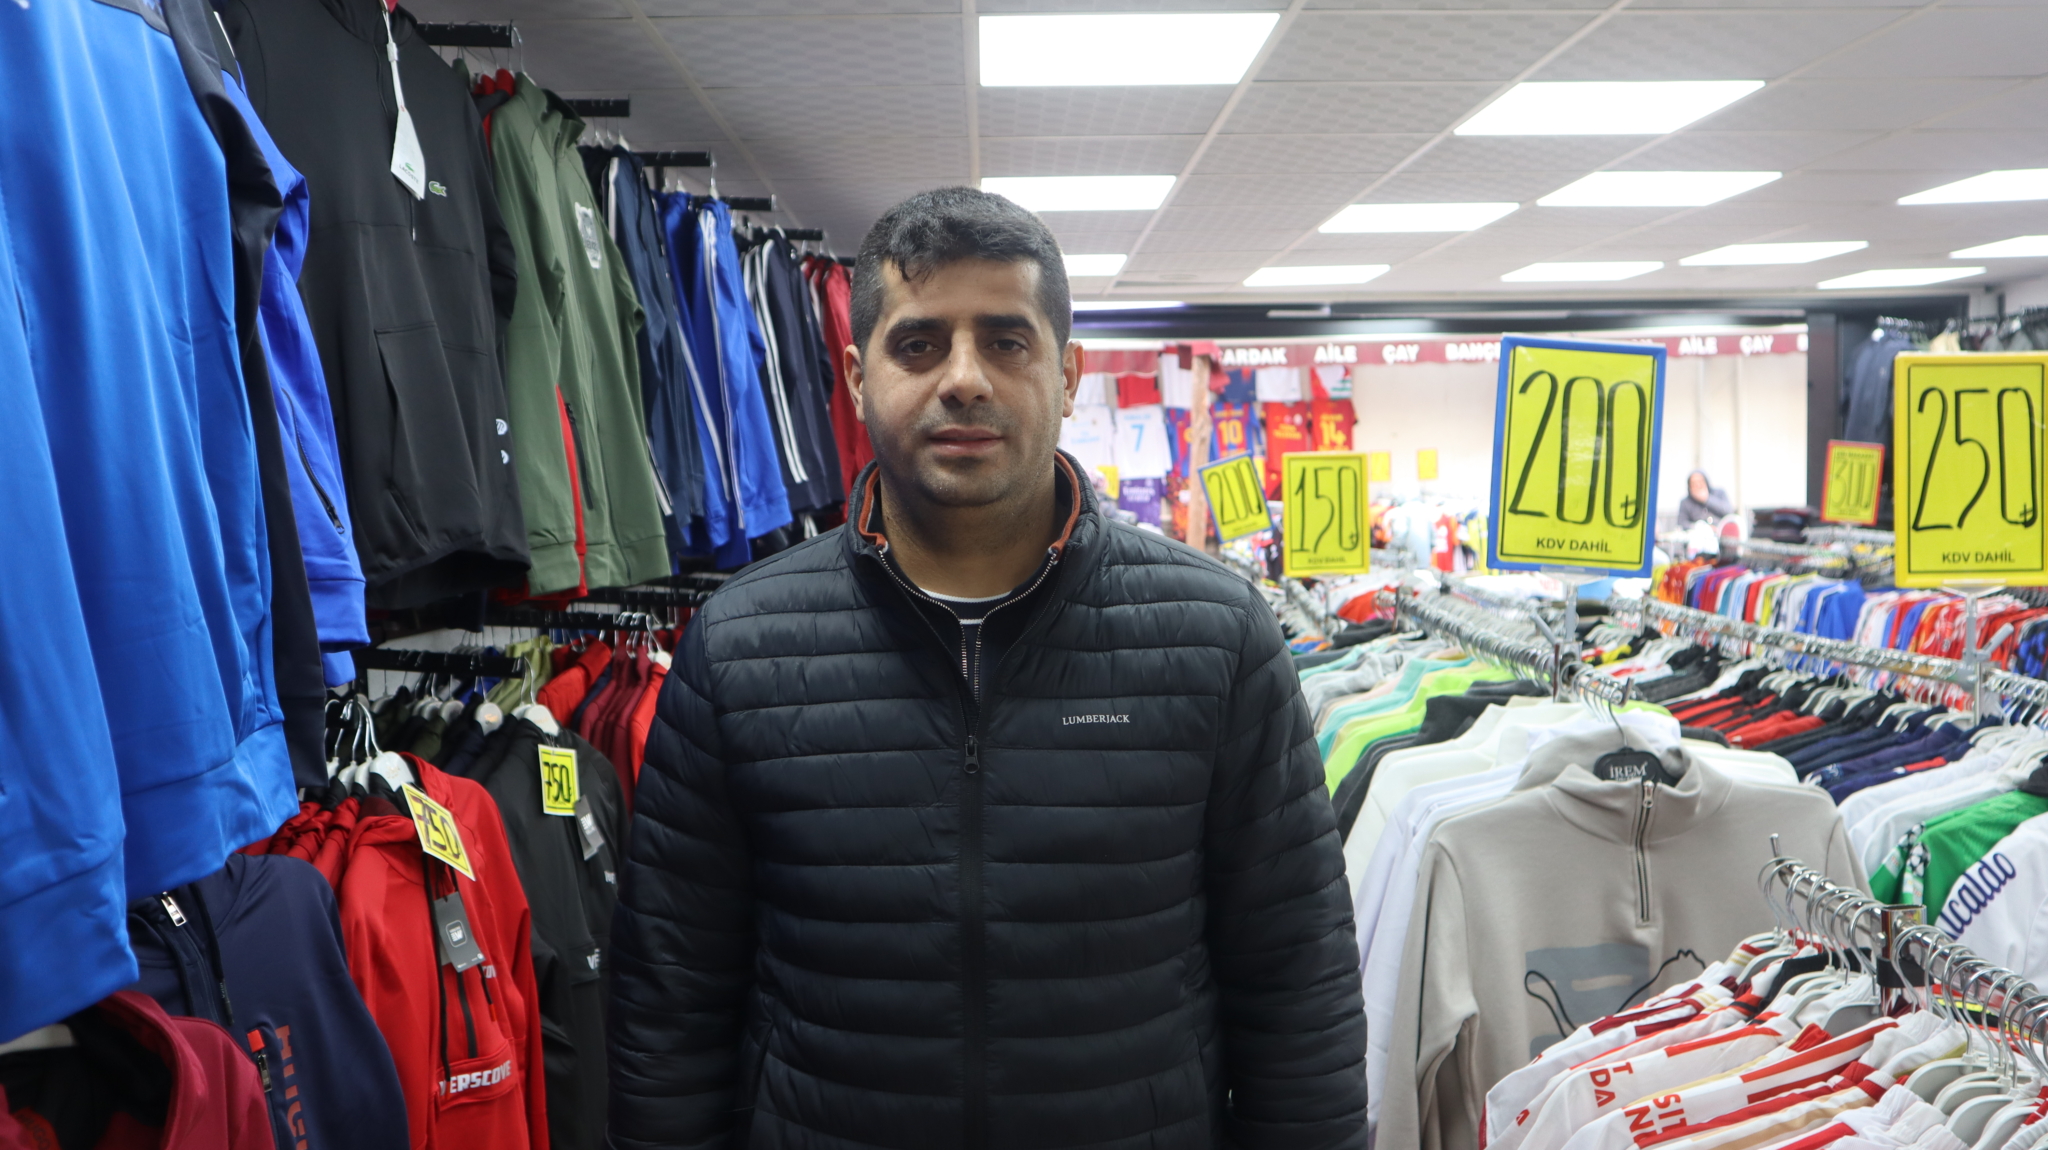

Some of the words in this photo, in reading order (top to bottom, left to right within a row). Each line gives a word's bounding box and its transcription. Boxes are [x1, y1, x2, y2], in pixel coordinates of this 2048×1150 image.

[1131, 424, 1144, 452] 7
[1218, 418, 1243, 445] 10
[1536, 537, 1566, 550] KDV
[1569, 537, 1612, 553] DAHİL
[1942, 551, 1971, 564] KDV
[1975, 549, 2016, 563] DAHİL
[1062, 714, 1130, 725] LUMBERJACK
